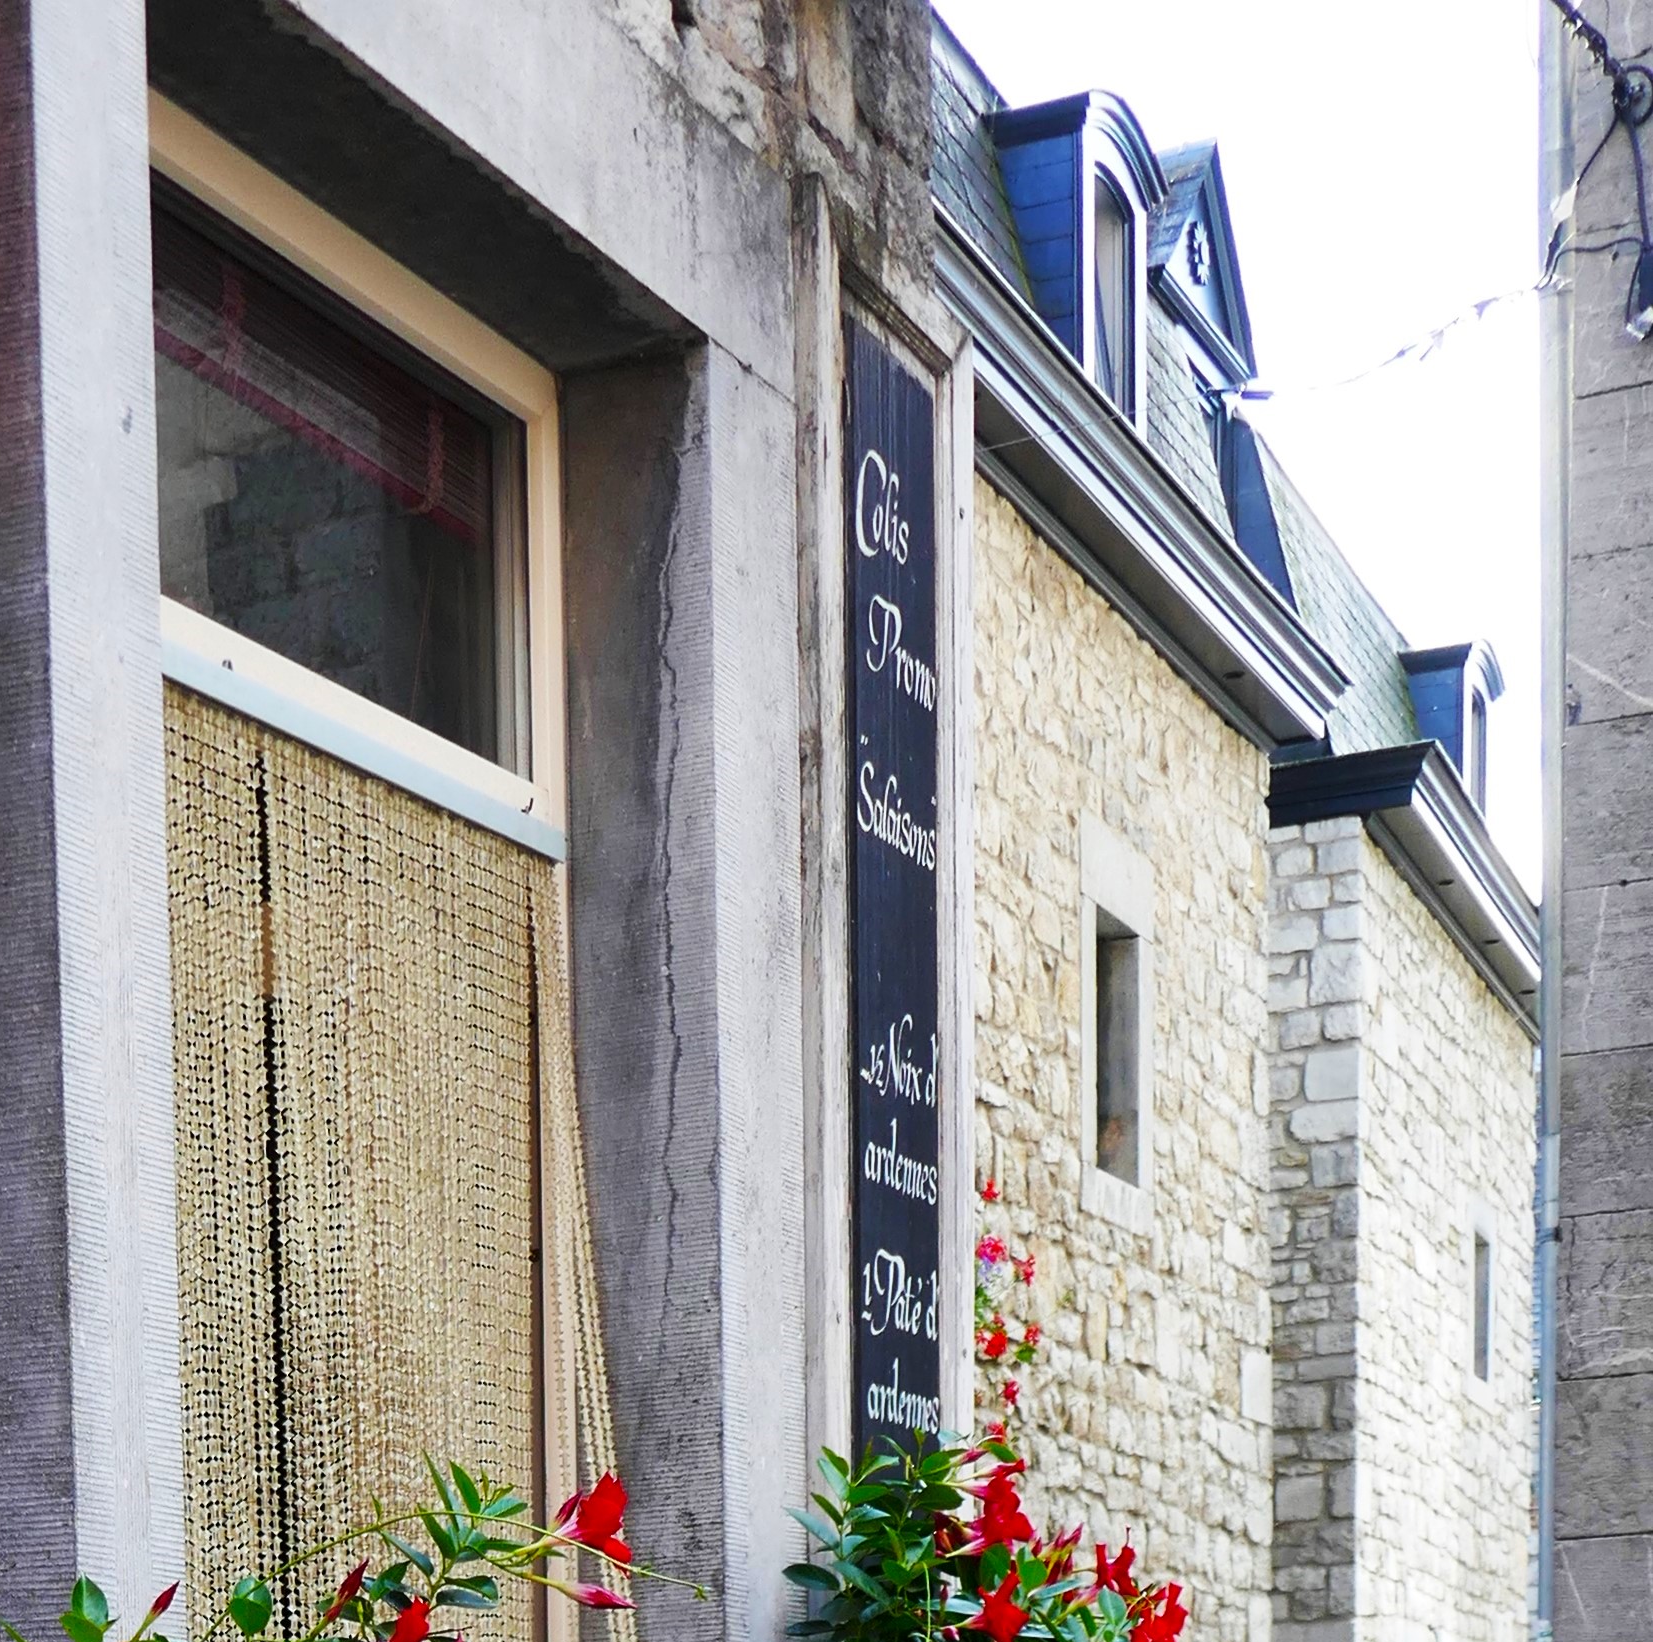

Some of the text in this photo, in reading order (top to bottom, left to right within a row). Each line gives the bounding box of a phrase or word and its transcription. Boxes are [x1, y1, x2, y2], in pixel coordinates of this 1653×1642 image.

[855, 449, 910, 566] Colis
[866, 594, 937, 713] Promo
[864, 1118, 938, 1206] ardennes
[867, 1357, 939, 1435] ardennes
